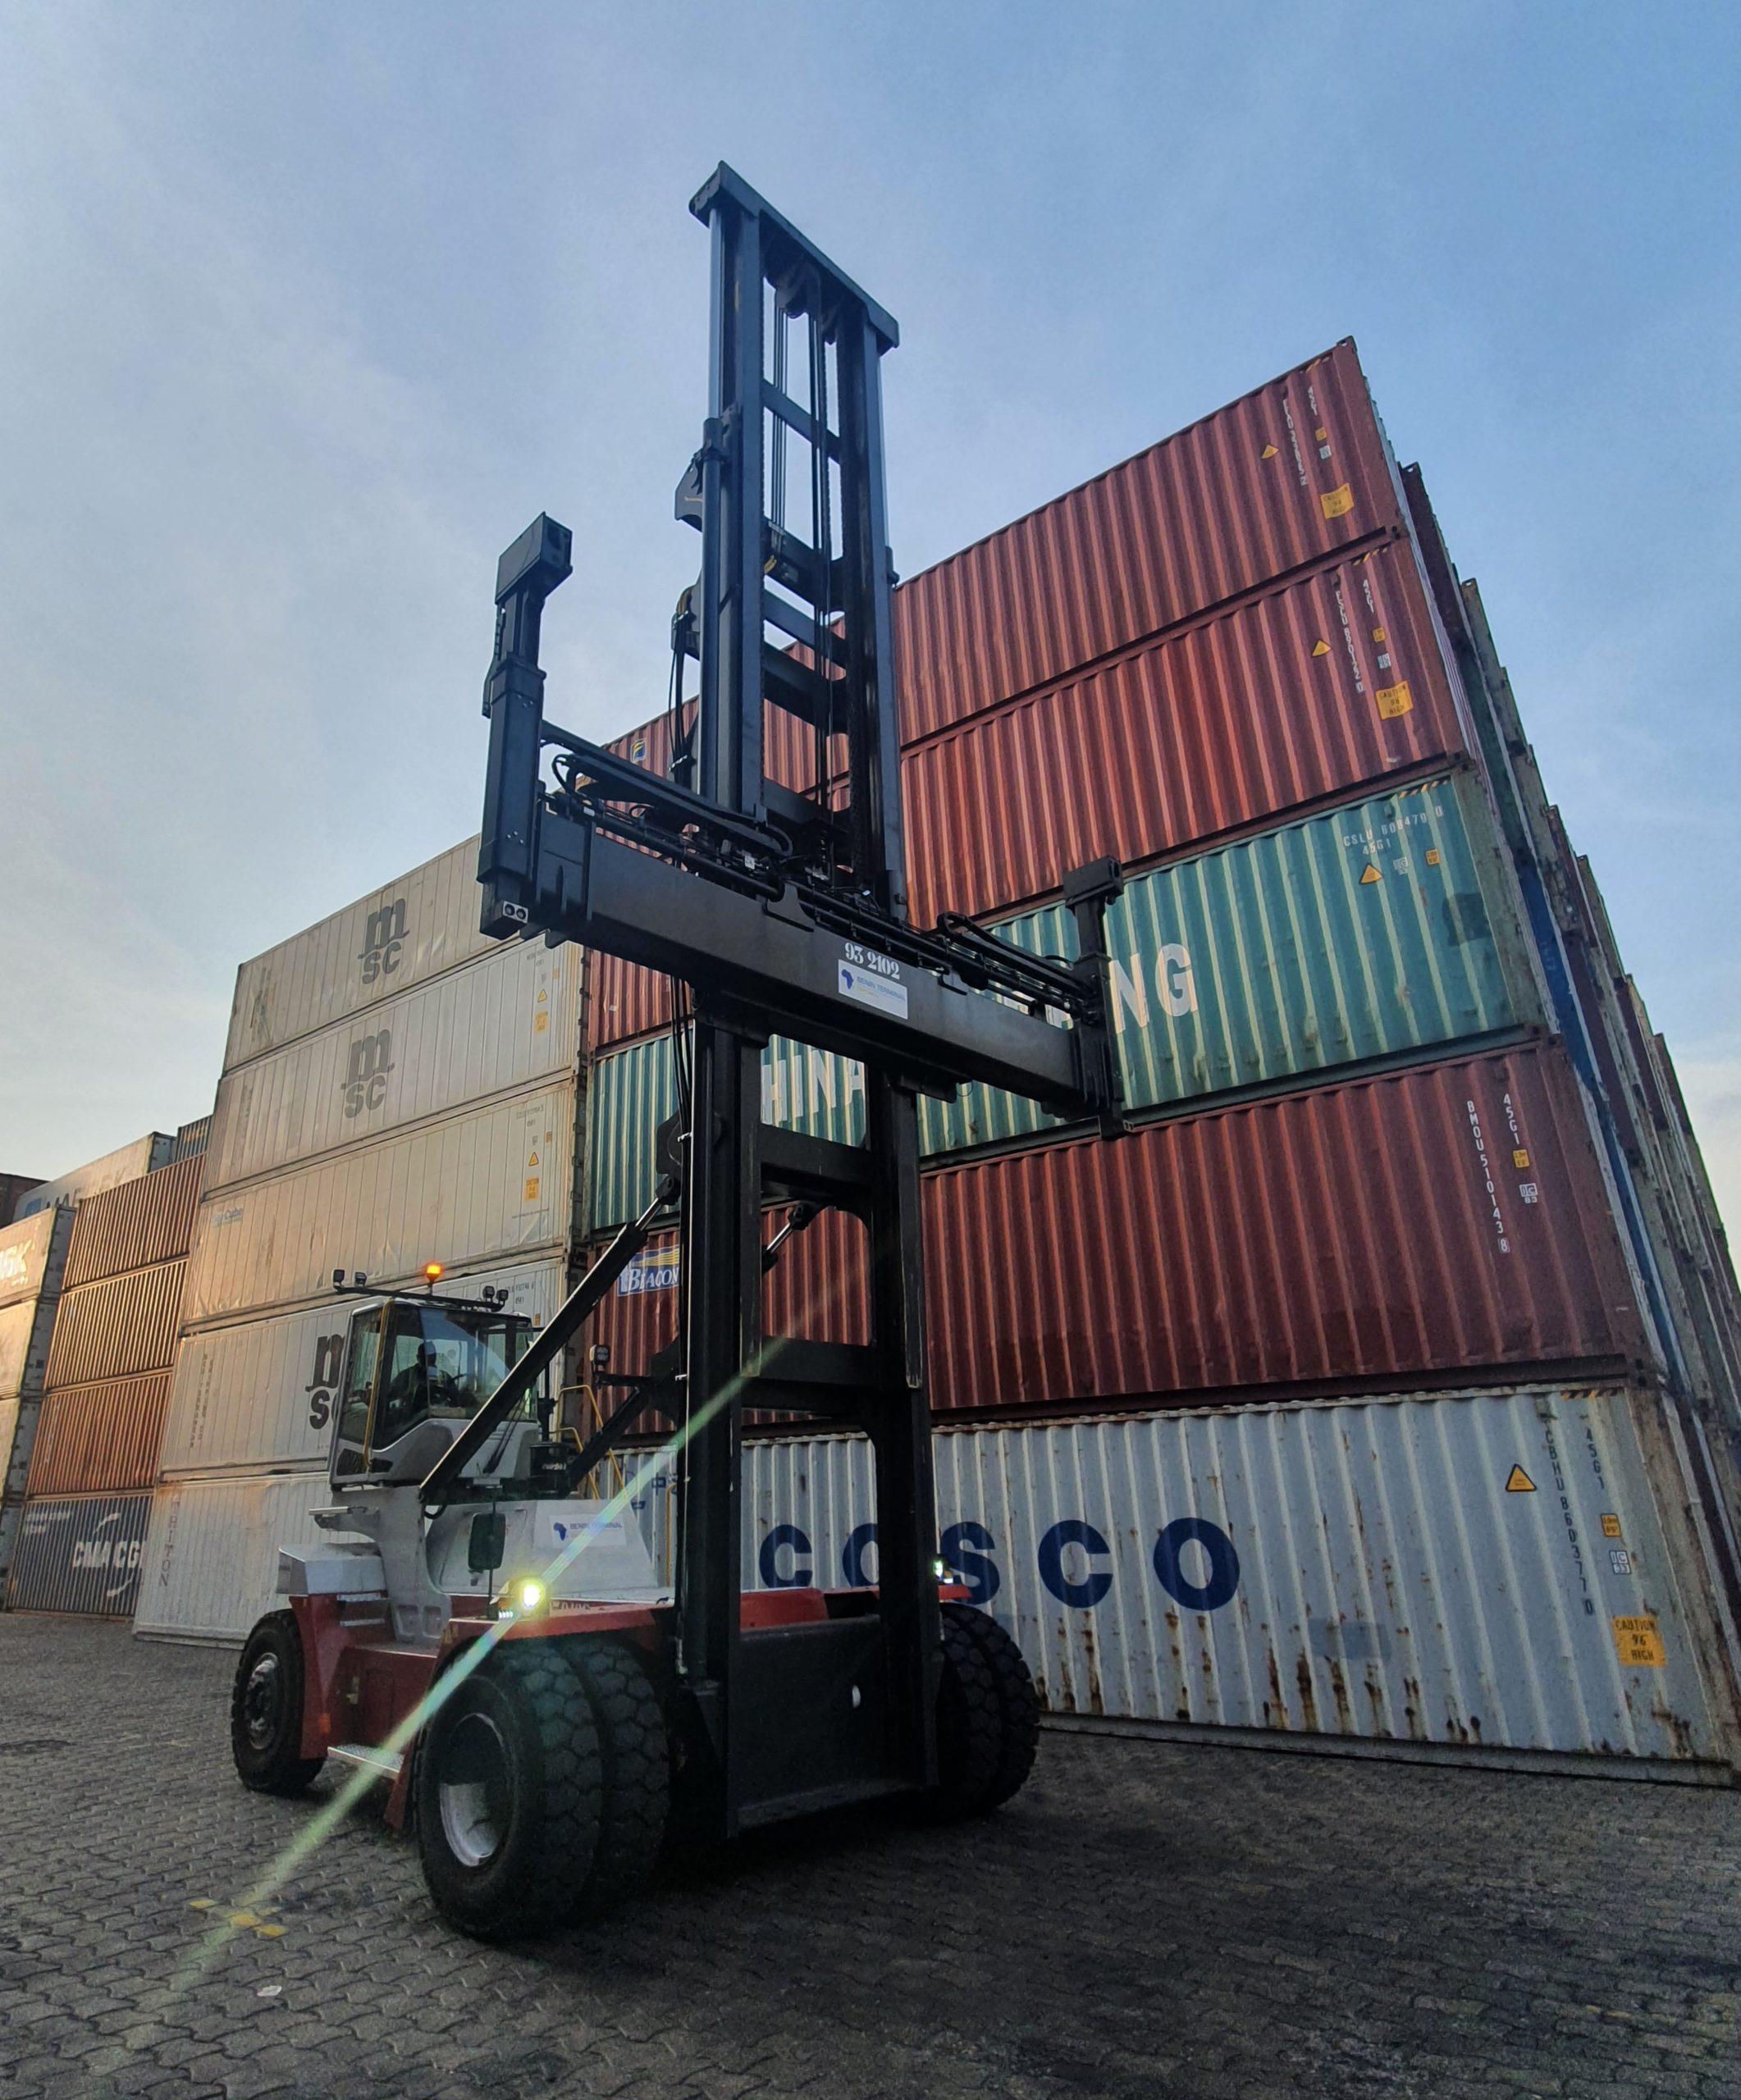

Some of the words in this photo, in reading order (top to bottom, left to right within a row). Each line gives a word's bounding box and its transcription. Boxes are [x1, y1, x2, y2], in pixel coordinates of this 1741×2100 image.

[1343, 829, 1373, 847] CSLU
[1362, 838, 1391, 855] 45G1
[844, 942, 864, 965] 93
[866, 951, 900, 980] 2102
[761, 1049, 866, 1125] HINA
[1503, 1093, 1519, 1144] 45G1
[1466, 1099, 1484, 1152] BMOU
[1479, 1153, 1504, 1235] 510143
[1585, 1427, 1605, 1490] 45G1
[1545, 1430, 1565, 1491] CBHU
[1560, 1495, 1588, 1593] 860377
[113, 1541, 146, 1568] CG
[1615, 1618, 1656, 1632] CAUTION
[1632, 1649, 1655, 1661] HIGH
